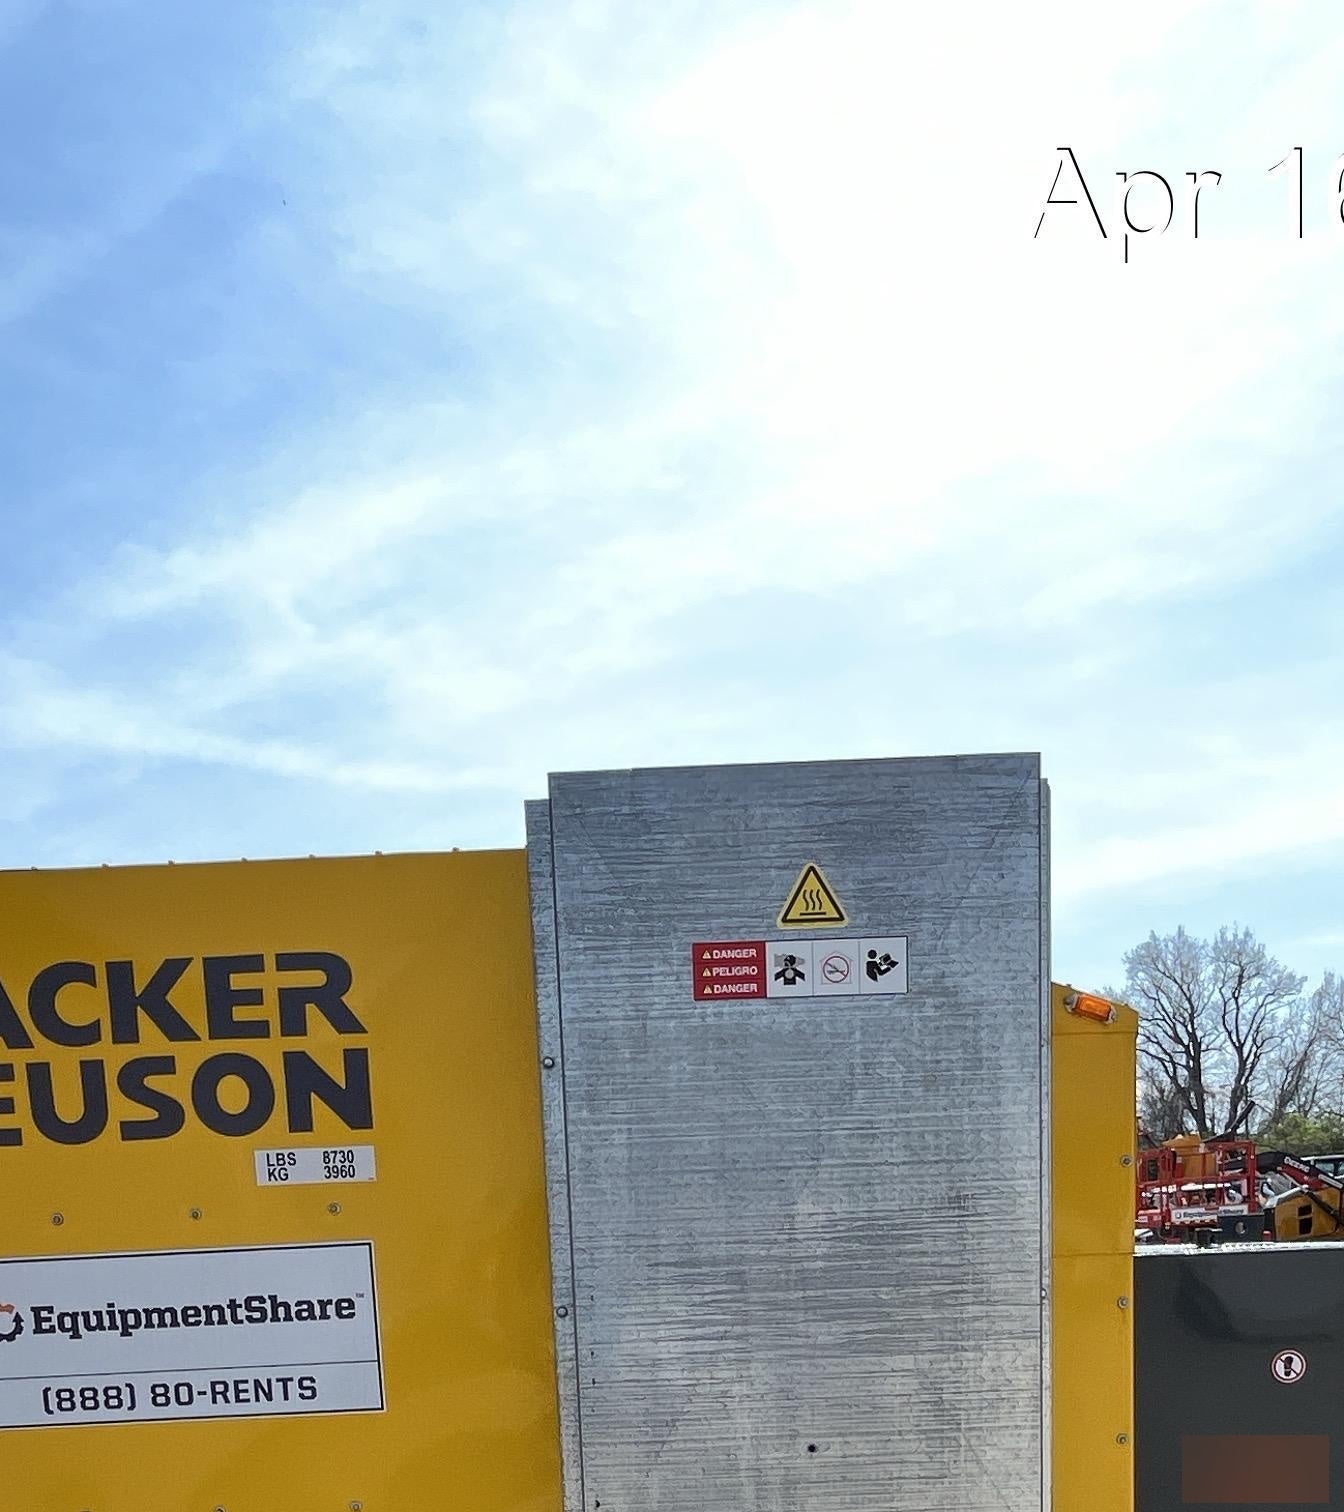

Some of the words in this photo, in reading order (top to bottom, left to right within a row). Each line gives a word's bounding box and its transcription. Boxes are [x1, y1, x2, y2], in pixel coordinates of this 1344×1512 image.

[712, 949, 757, 959] DANGER
[712, 966, 758, 977] PELIGRO
[713, 984, 758, 994] DANGER
[266, 1152, 297, 1167] LBS
[322, 1150, 355, 1164] 8730
[268, 1167, 289, 1182] KG
[324, 1165, 356, 1179] 3960
[31, 1295, 357, 1339] EquipmentShare
[42, 1382, 137, 1415] (888)
[150, 1376, 319, 1408] 80-RENTS
